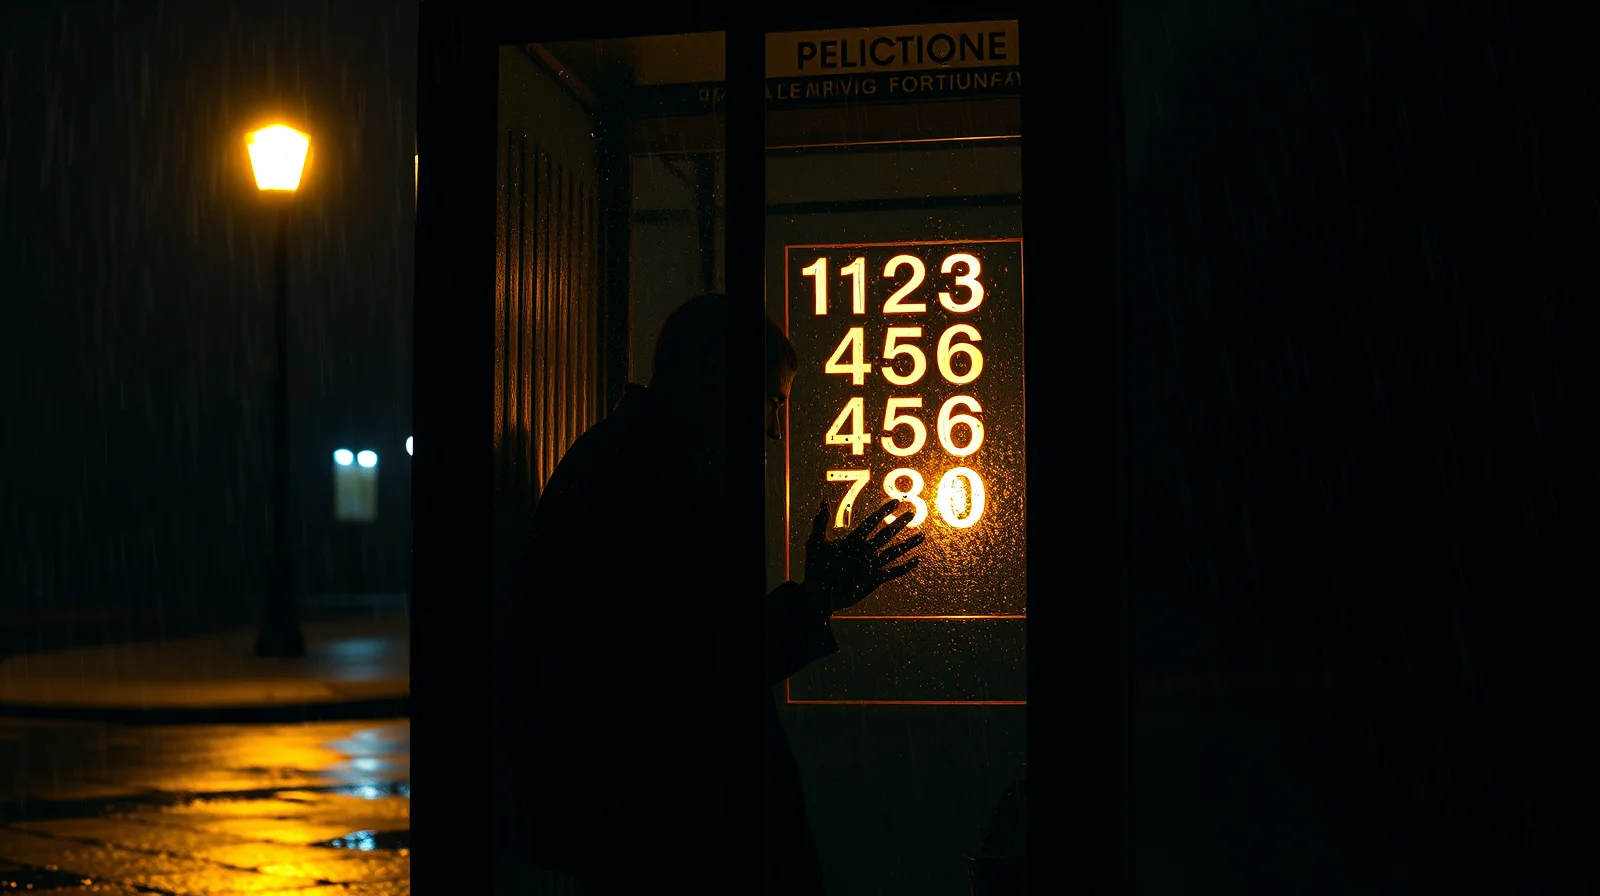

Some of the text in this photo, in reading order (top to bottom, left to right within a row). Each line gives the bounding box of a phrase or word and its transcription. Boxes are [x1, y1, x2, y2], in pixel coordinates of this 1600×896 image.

[797, 32, 1006, 69] PELICTIONE
[824, 323, 984, 386] 456
[825, 395, 985, 457] 456
[826, 466, 986, 529] 780
